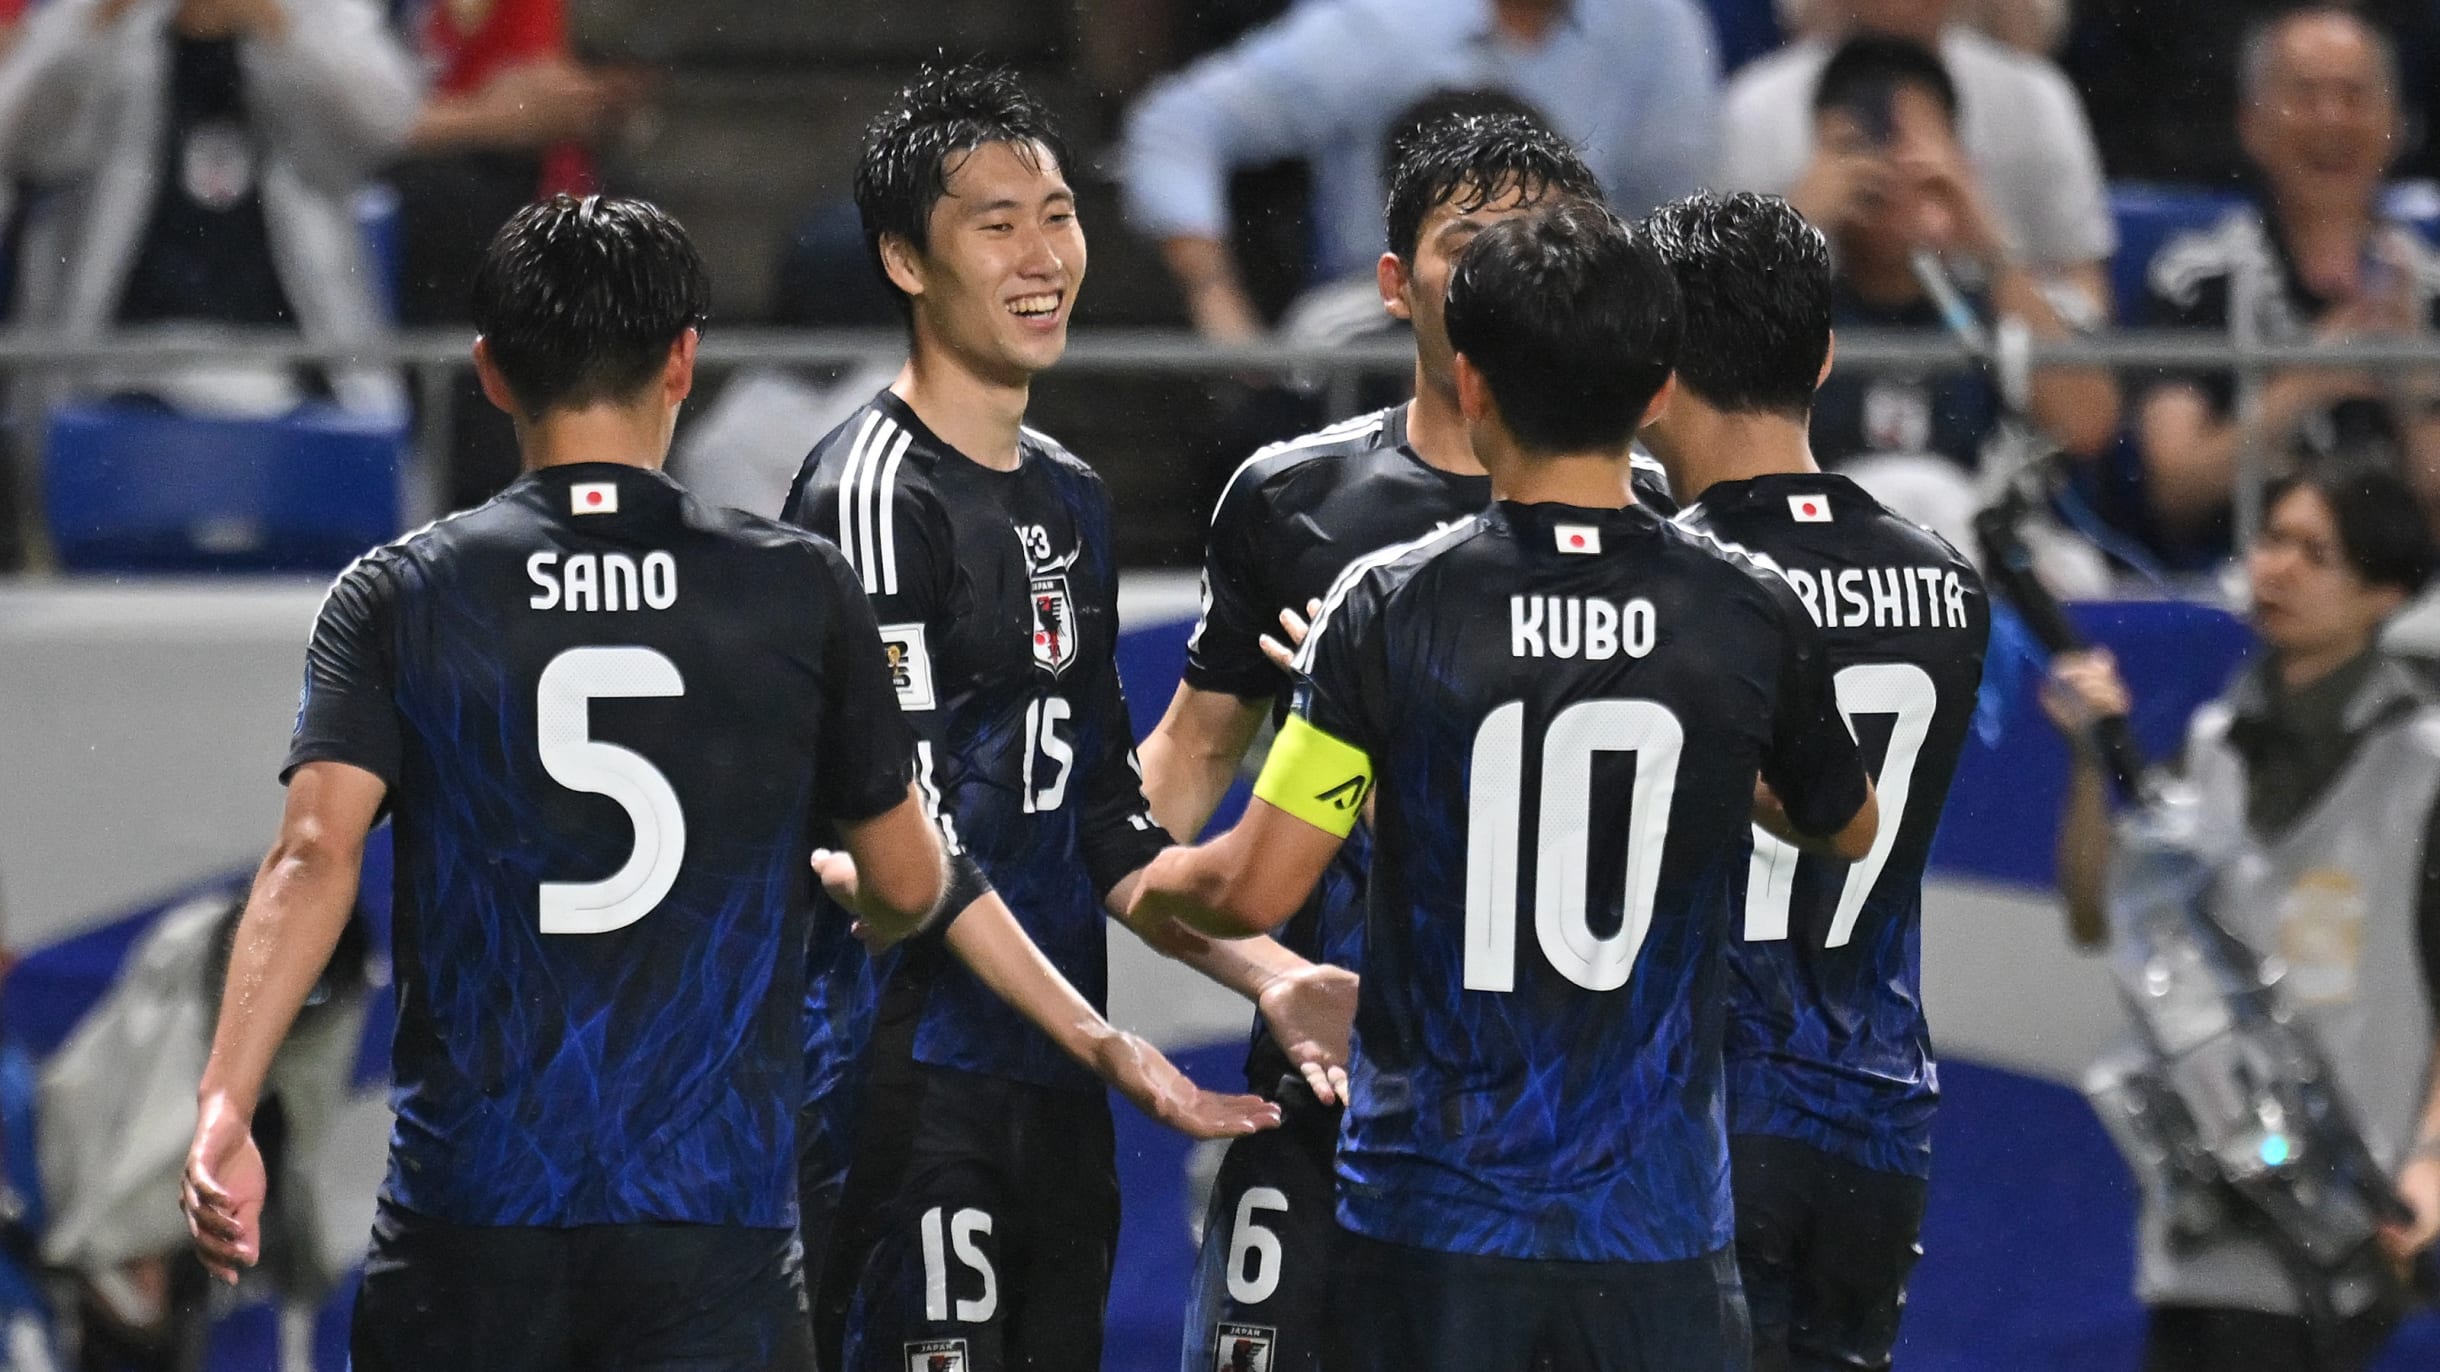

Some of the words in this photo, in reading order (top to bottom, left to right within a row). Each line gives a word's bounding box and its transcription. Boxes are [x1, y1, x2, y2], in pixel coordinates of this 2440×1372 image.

[1013, 525, 1050, 559] Y-3
[526, 550, 678, 611] SANO
[1787, 567, 1967, 628] RISHITA
[1510, 596, 1656, 660] KUBO
[1023, 698, 1073, 813] 15
[537, 645, 687, 934] 5
[1463, 700, 1684, 992] 10
[921, 1206, 997, 1323] 15
[1226, 1186, 1289, 1304] 6
[921, 1343, 953, 1353] JAPAN
[1230, 1327, 1261, 1337] JAPAN
